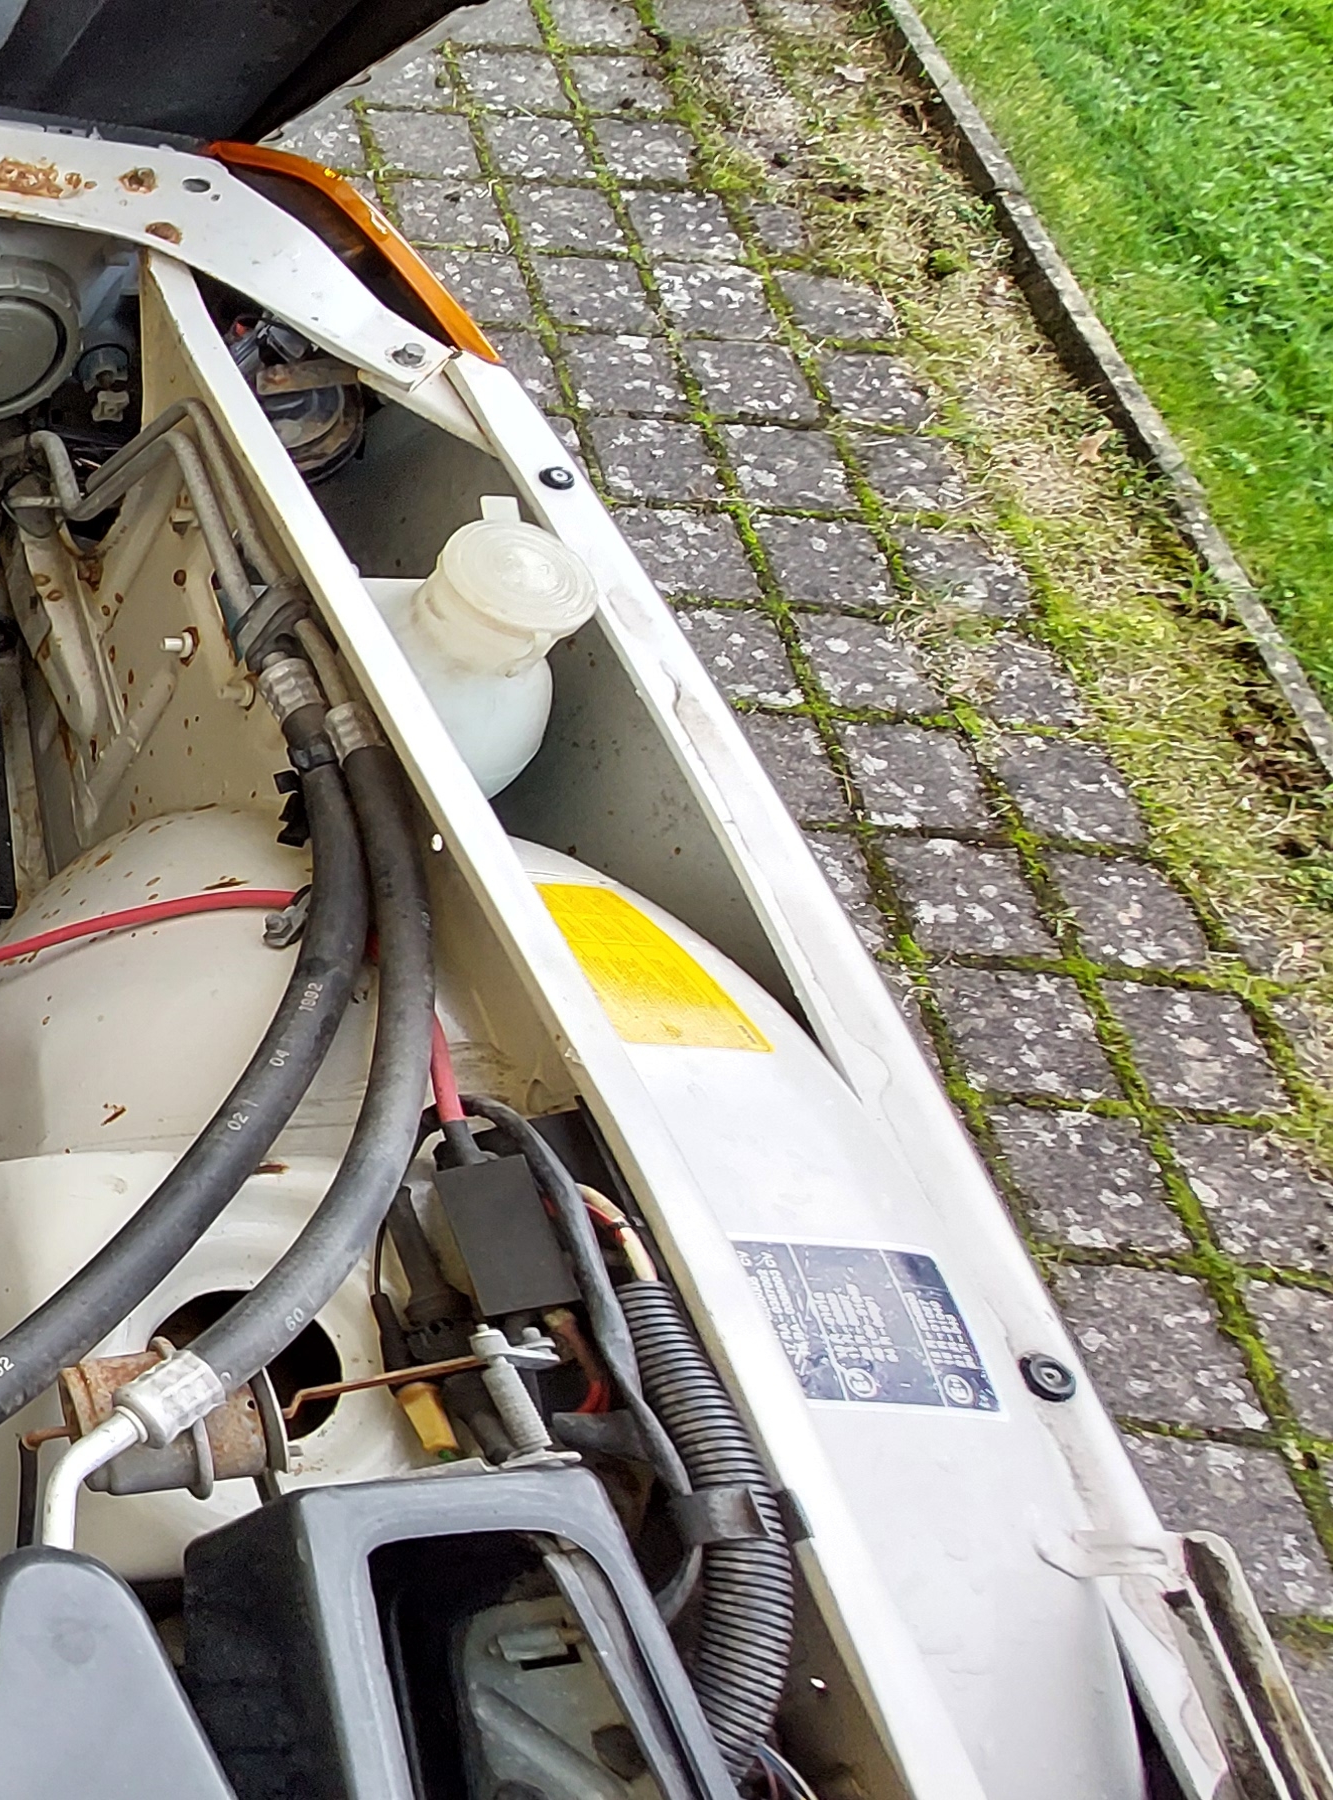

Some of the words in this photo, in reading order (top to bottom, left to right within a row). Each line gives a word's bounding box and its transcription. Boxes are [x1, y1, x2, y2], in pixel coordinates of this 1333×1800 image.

[227, 1112, 250, 1131] 02
[269, 1049, 291, 1067] 04
[298, 983, 323, 1012] 1992
